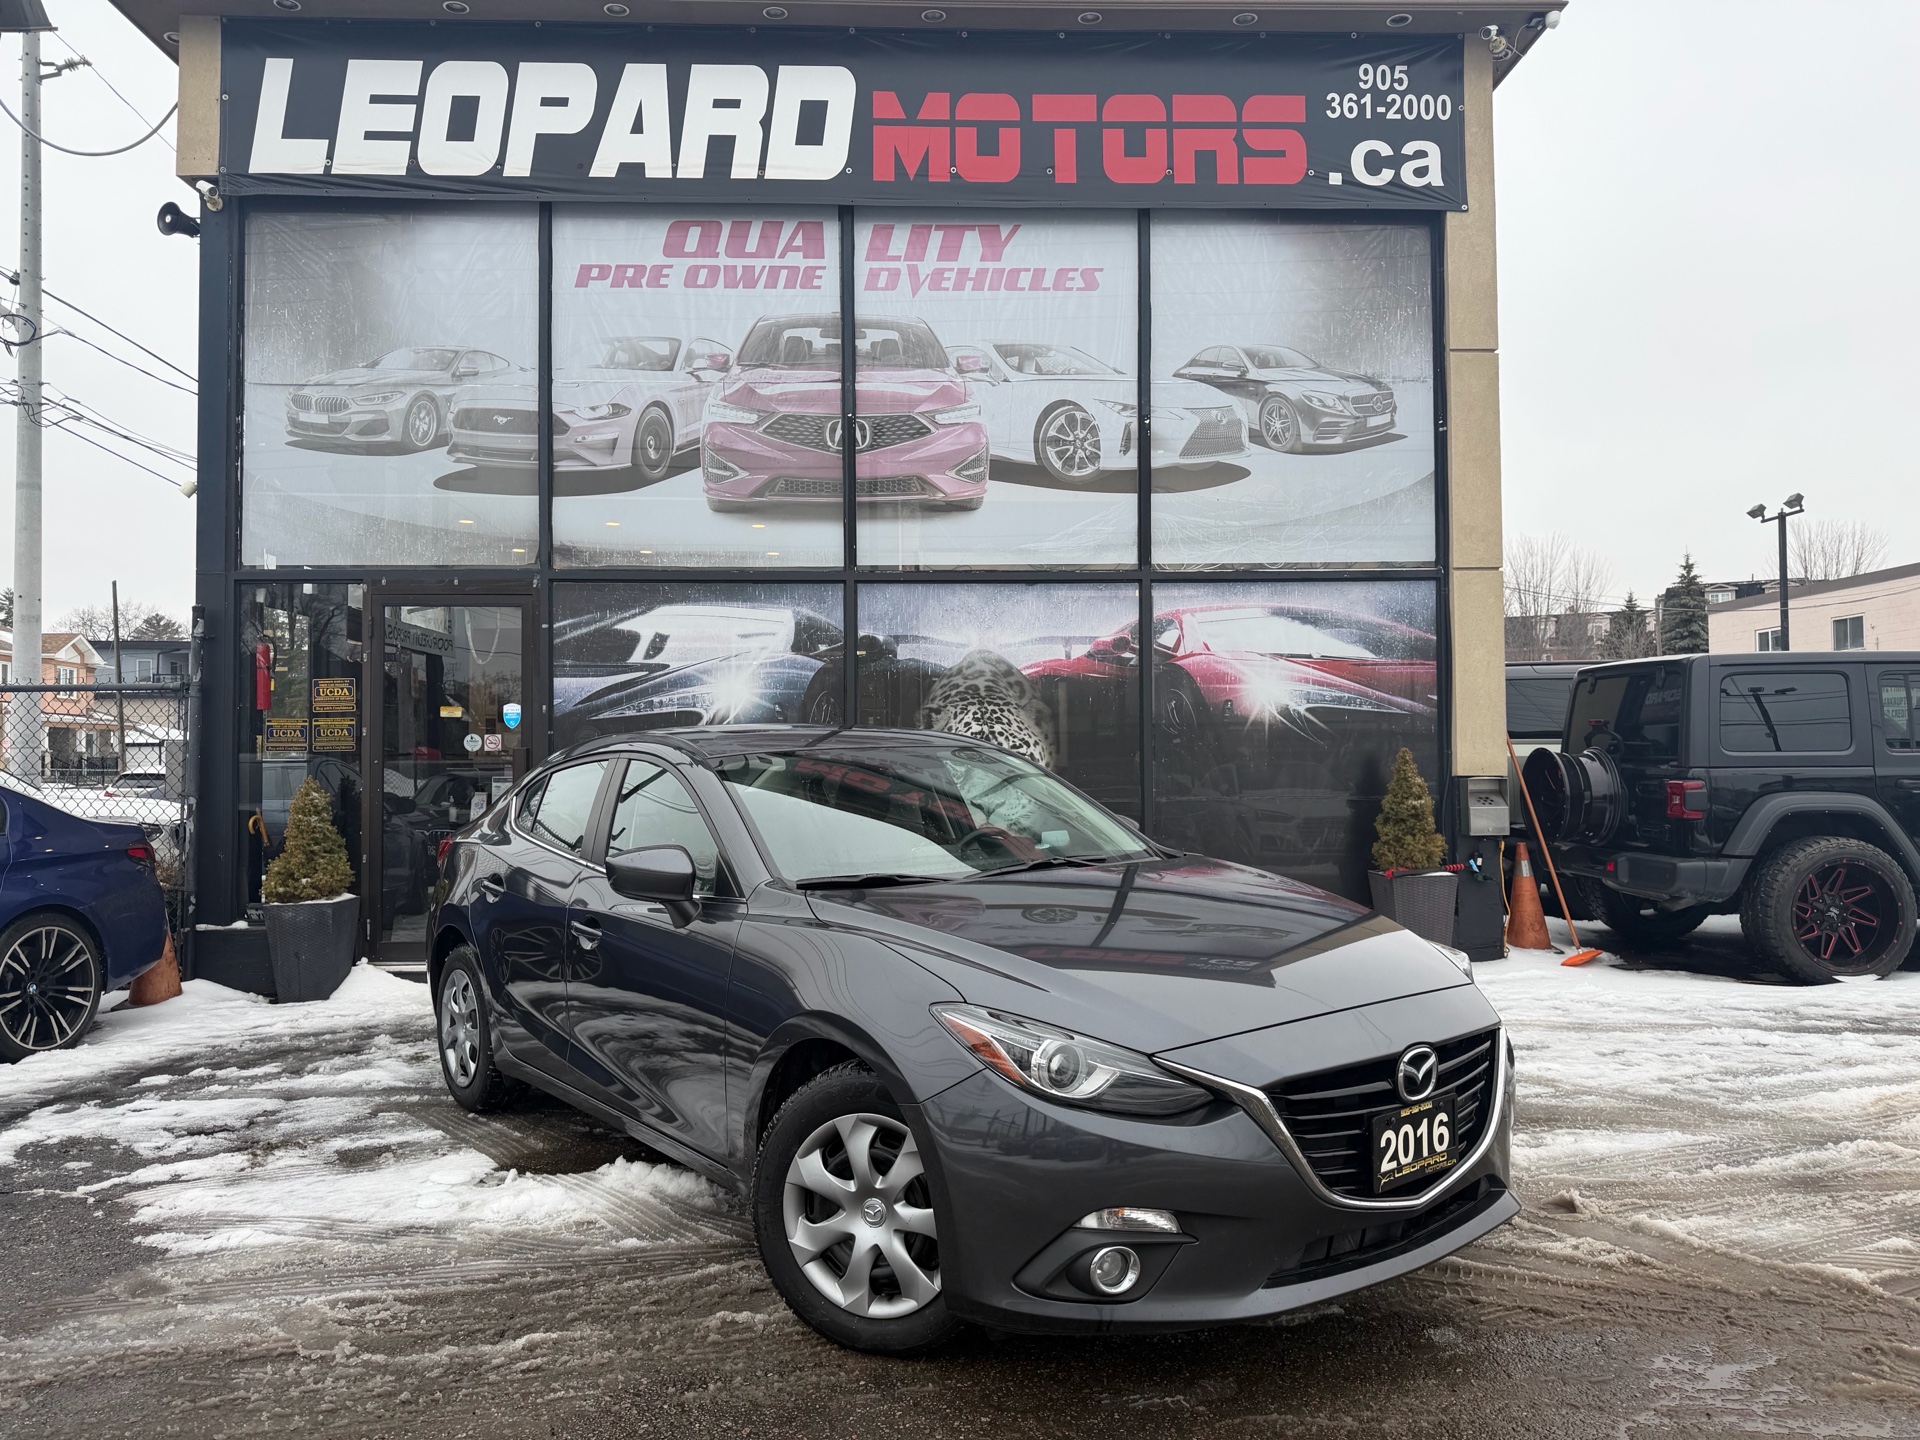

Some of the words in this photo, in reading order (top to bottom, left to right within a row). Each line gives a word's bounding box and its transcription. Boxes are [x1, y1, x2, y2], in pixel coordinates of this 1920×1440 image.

[1358, 63, 1409, 91] 905
[1325, 92, 1452, 121] 361-2000
[248, 58, 857, 180] LEOPARD
[873, 91, 1307, 185] MOTORS
[1328, 139, 1445, 188] .ca
[662, 220, 826, 259] QUA
[864, 223, 1022, 262] LITY
[574, 263, 674, 289] PRE
[683, 264, 827, 290] OWNE
[319, 687, 350, 696] UCDA
[273, 729, 302, 737] UCDA
[320, 728, 349, 737] UCDA
[1380, 1112, 1450, 1173] 2016
[1395, 1152, 1447, 1177] LEOPARD
